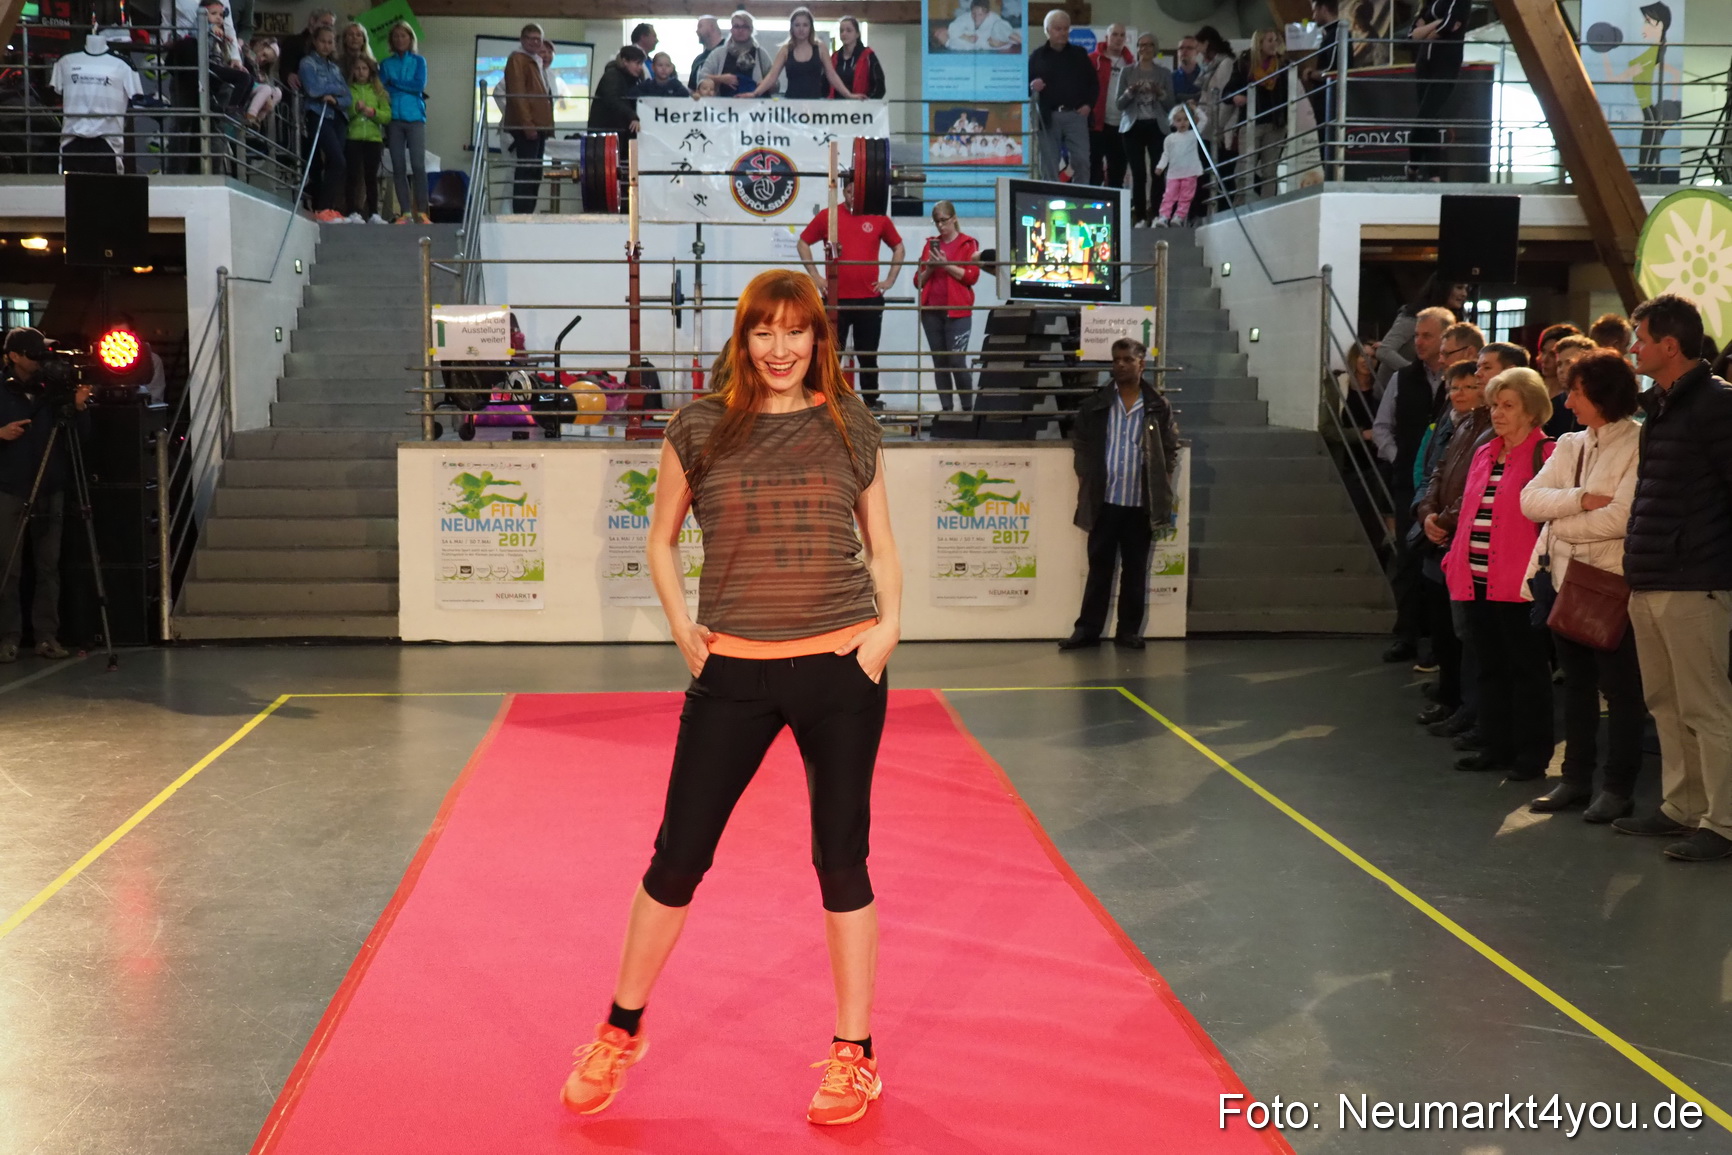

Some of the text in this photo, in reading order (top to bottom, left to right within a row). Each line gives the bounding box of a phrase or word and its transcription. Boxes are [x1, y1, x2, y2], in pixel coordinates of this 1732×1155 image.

[654, 107, 873, 124] Herzlich willkommen
[740, 131, 790, 147] beim
[1347, 131, 1390, 148] BODY
[735, 180, 794, 212] OBERÖLSBACH
[1108, 318, 1125, 327] geht
[461, 327, 506, 335] Ausstellung
[1084, 327, 1127, 335] Ausstellung
[491, 503, 537, 517] FIT IN
[985, 502, 1030, 515] FIT IN
[441, 518, 537, 532] NEUMARKT
[937, 516, 1030, 529] NEUMARKT
[498, 533, 537, 547] 2017
[992, 530, 1030, 544] 2017
